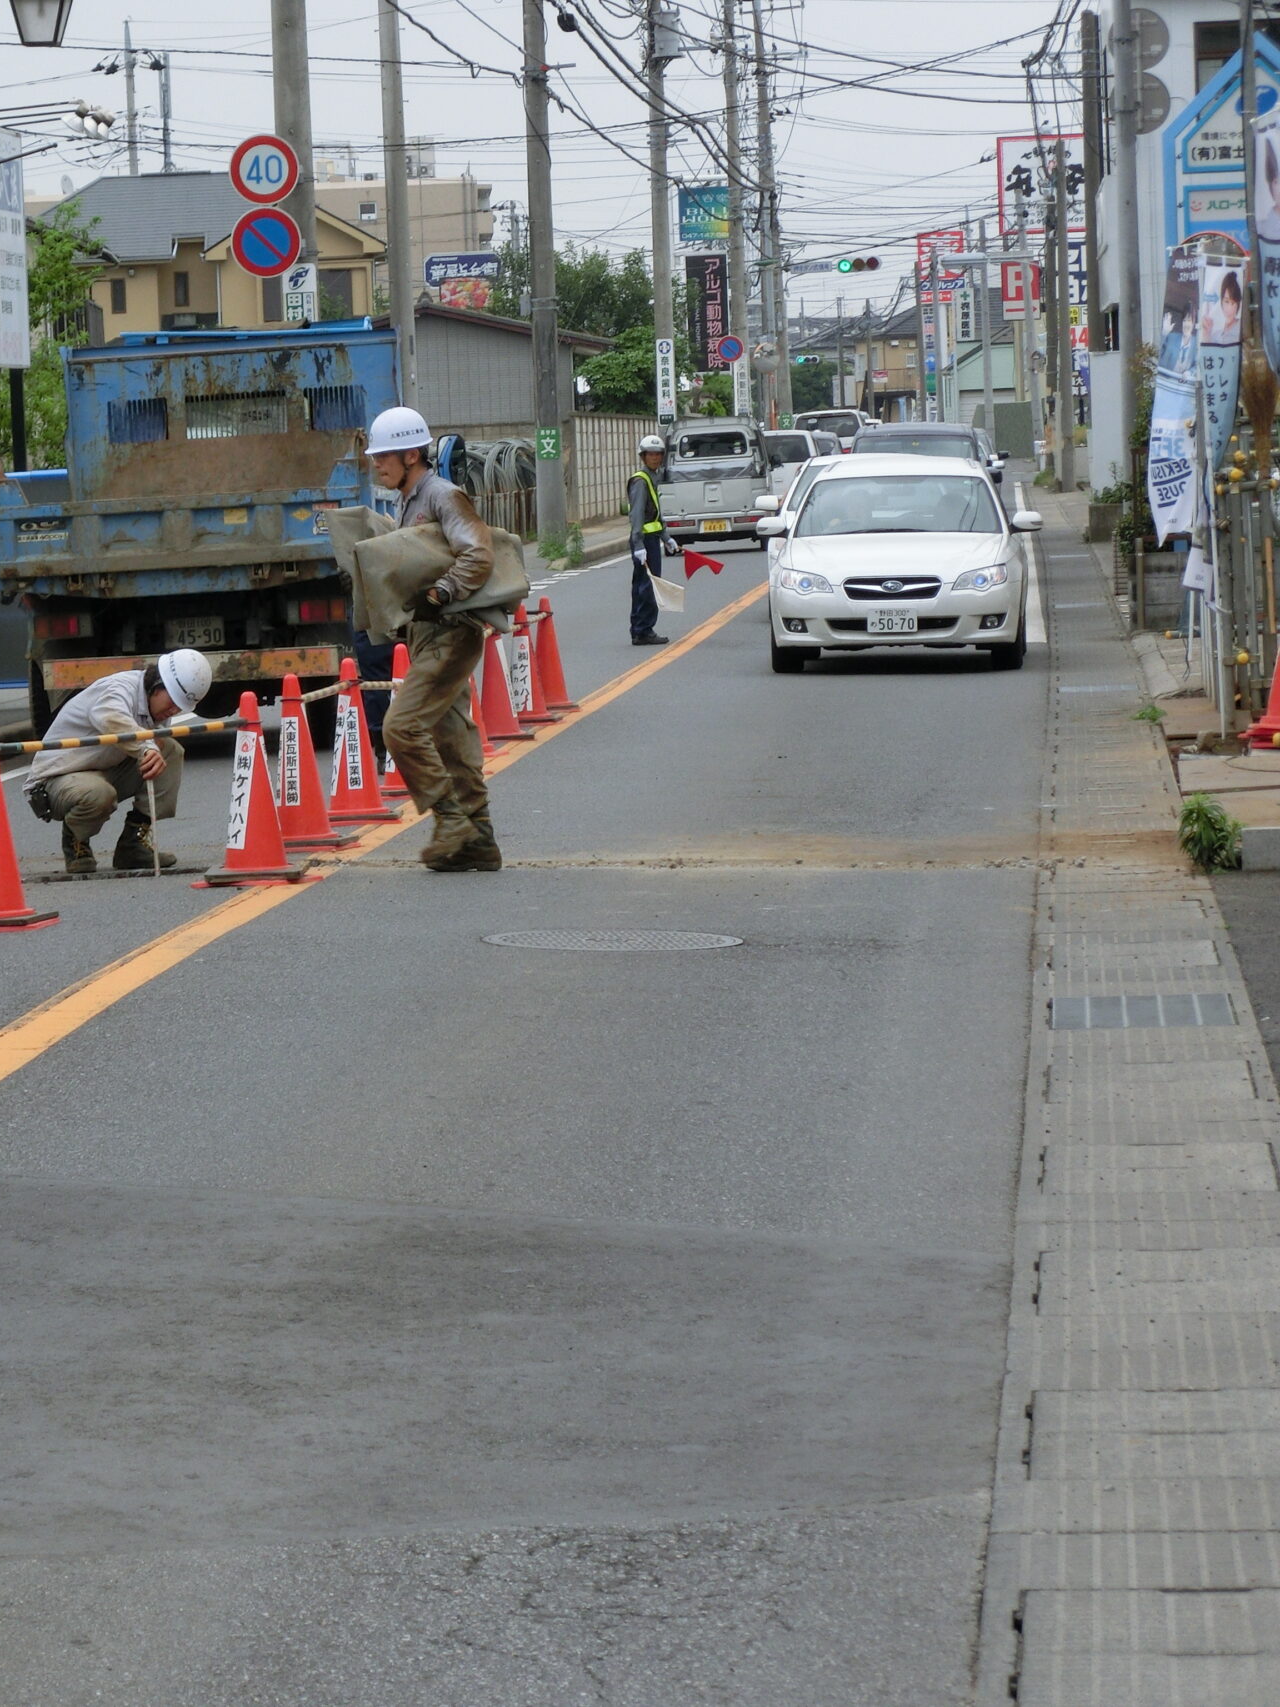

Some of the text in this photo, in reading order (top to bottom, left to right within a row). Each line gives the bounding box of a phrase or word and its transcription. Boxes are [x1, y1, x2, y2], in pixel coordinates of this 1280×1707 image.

[246, 154, 283, 185] 40
[920, 280, 963, 290] ウルシア
[540, 437, 556, 454] 文
[878, 617, 915, 631] 50-70
[178, 628, 221, 646] 45-90
